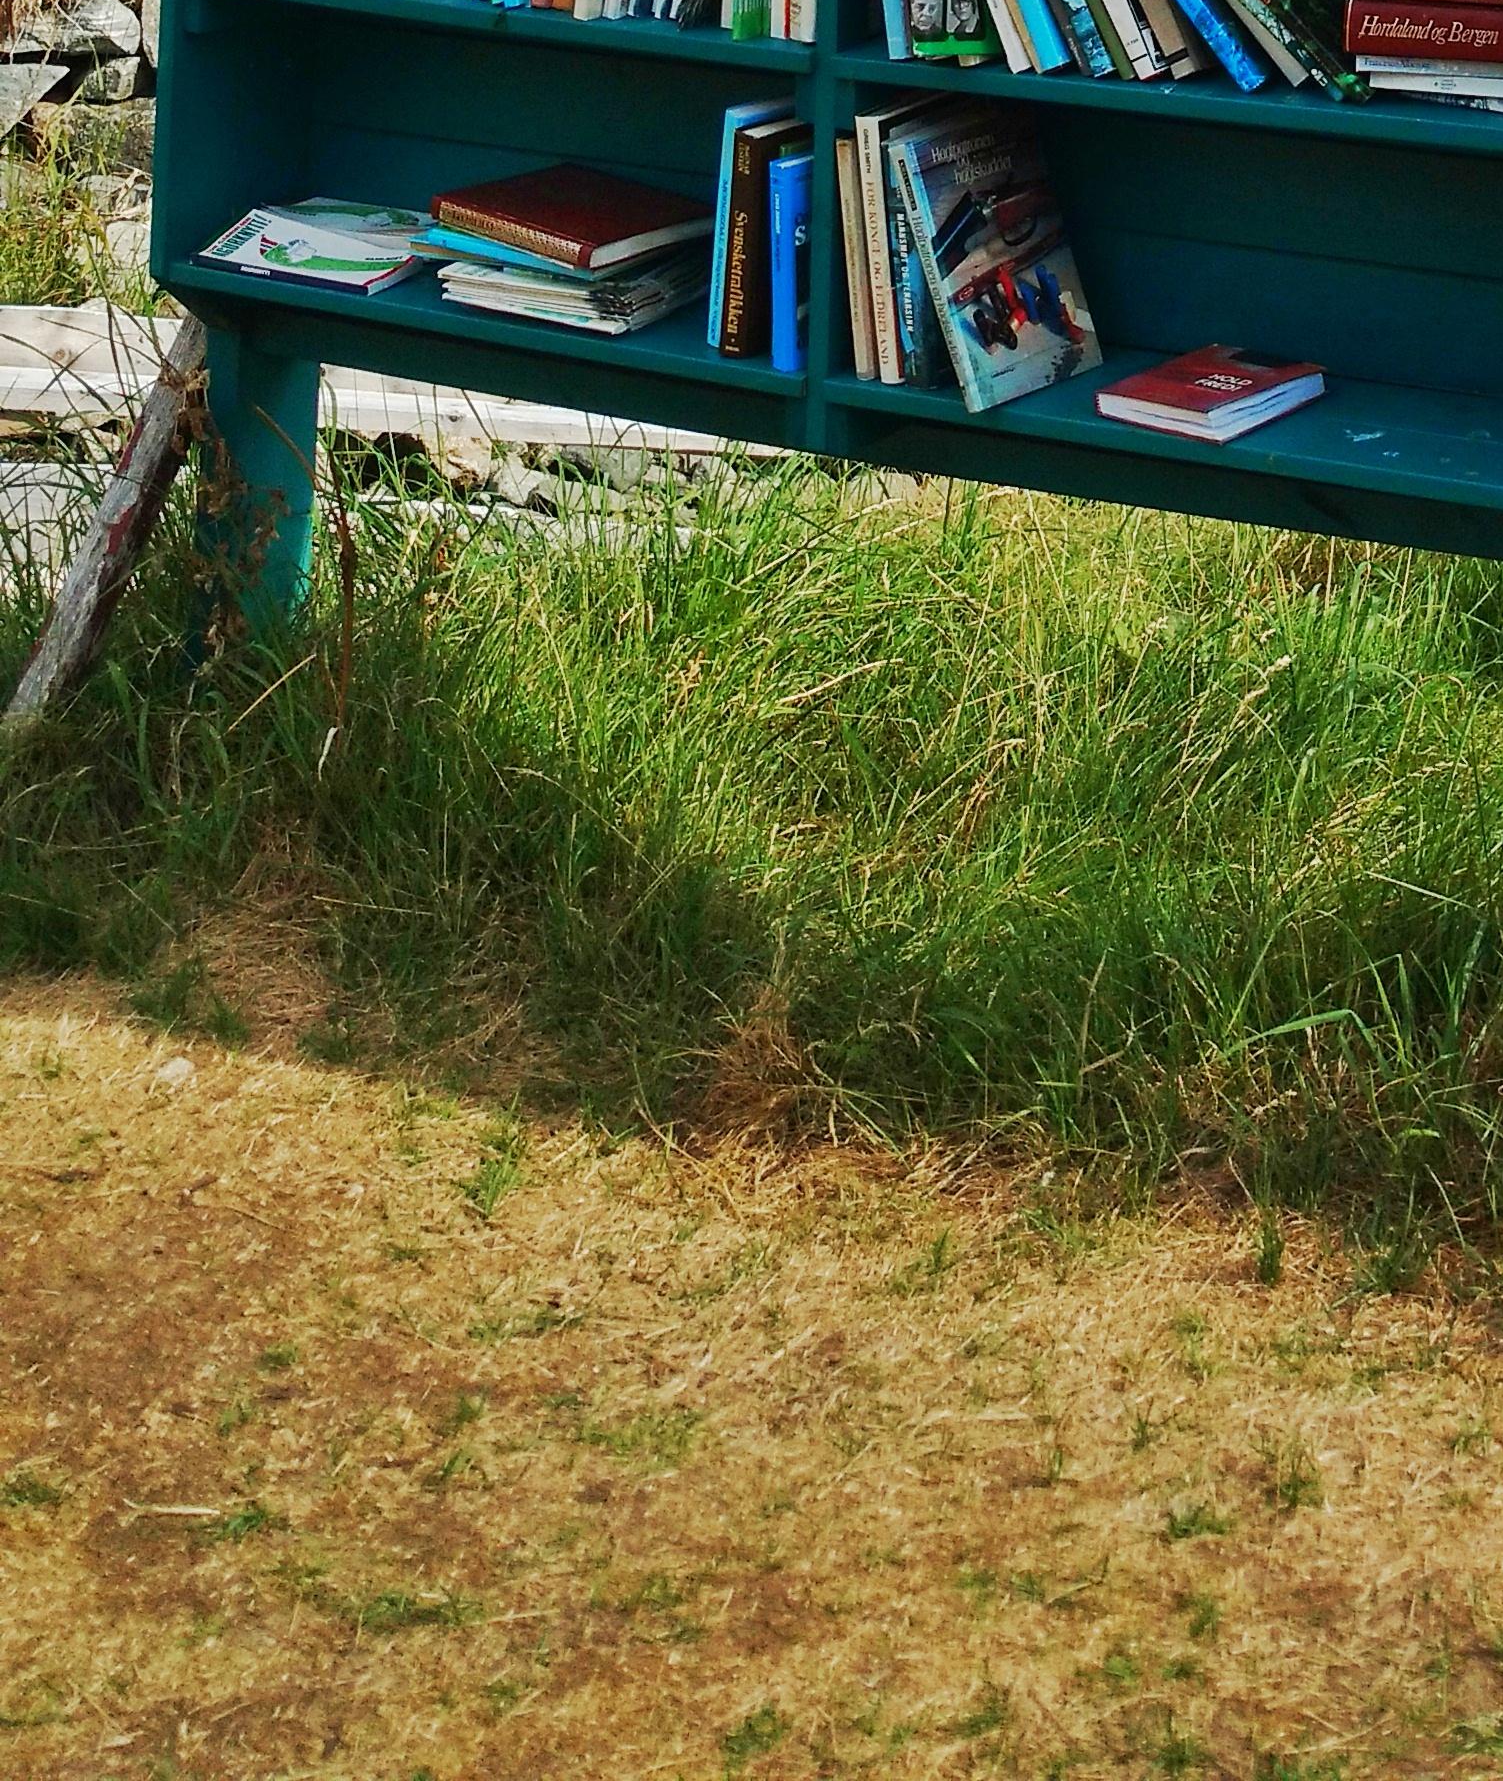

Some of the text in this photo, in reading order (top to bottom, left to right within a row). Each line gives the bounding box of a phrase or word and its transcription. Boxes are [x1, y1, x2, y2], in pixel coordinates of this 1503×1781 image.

[1359, 15, 1500, 47] Hordaland og Bergen
[210, 213, 272, 258] AGURKNYTT!
[895, 211, 910, 264] MANNSMOT
[864, 180, 891, 365] FOR KONGE OG FEDRELAND
[900, 265, 910, 279] OG
[1208, 374, 1254, 386] HOLD
